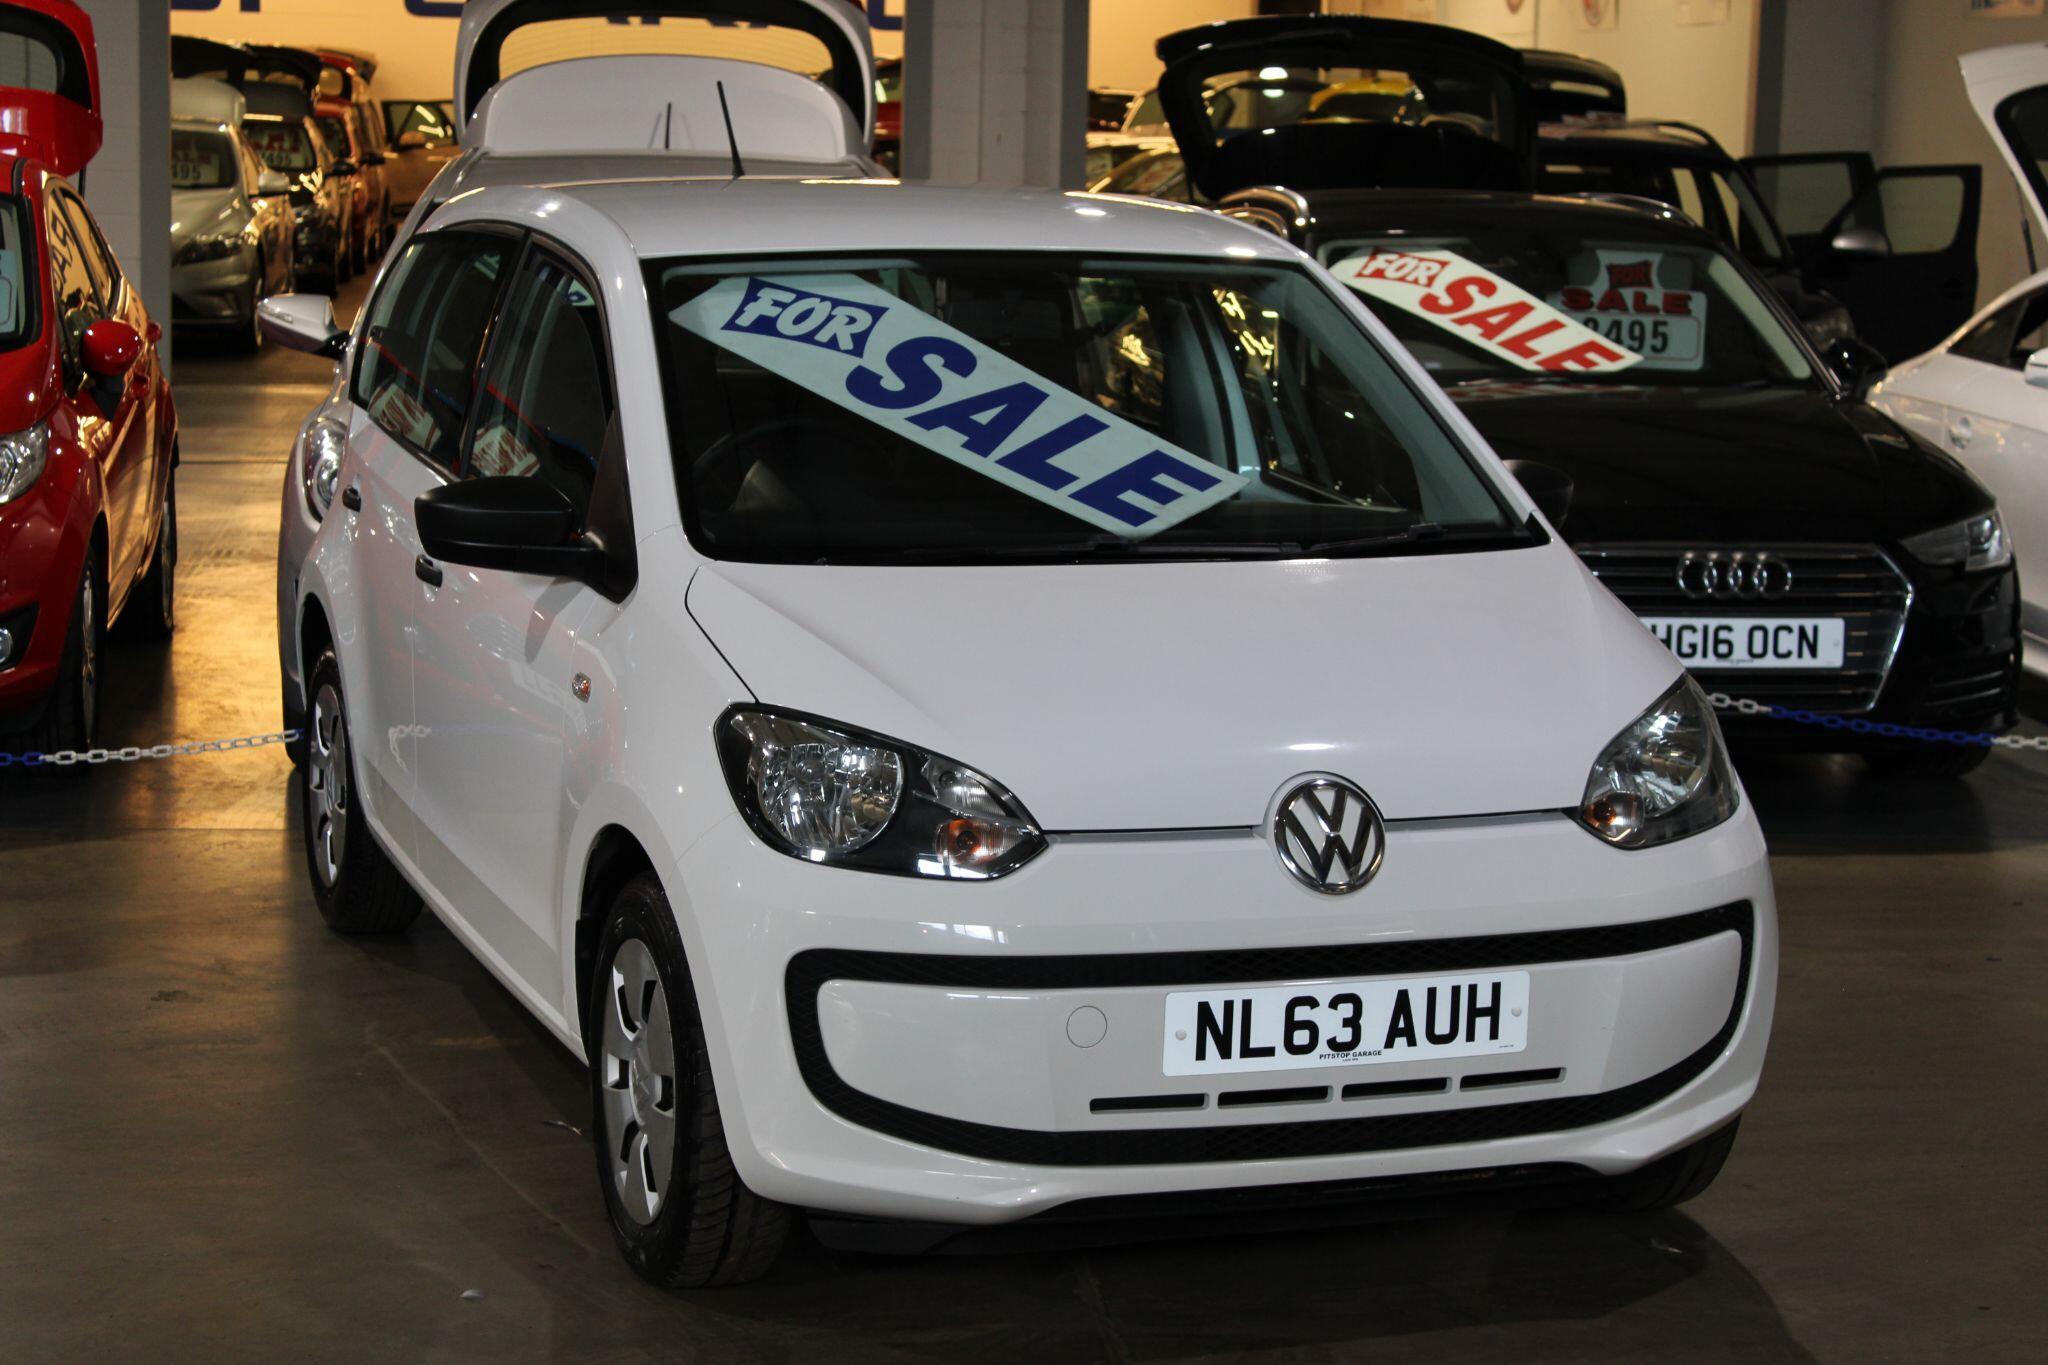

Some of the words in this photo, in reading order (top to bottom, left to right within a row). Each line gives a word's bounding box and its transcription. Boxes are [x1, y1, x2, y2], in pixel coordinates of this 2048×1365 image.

[1361, 252, 1443, 286] FOR
[1419, 276, 1626, 372] SALE
[1561, 287, 1693, 316] SALE
[733, 286, 874, 352] FOR
[845, 336, 1223, 528] SALE
[1747, 624, 1819, 660] OCN
[1195, 992, 1363, 1062] NL63
[1383, 981, 1502, 1049] AUH
[1319, 1052, 1351, 1060] PITSTOP
[1352, 1050, 1382, 1058] GARAGE
